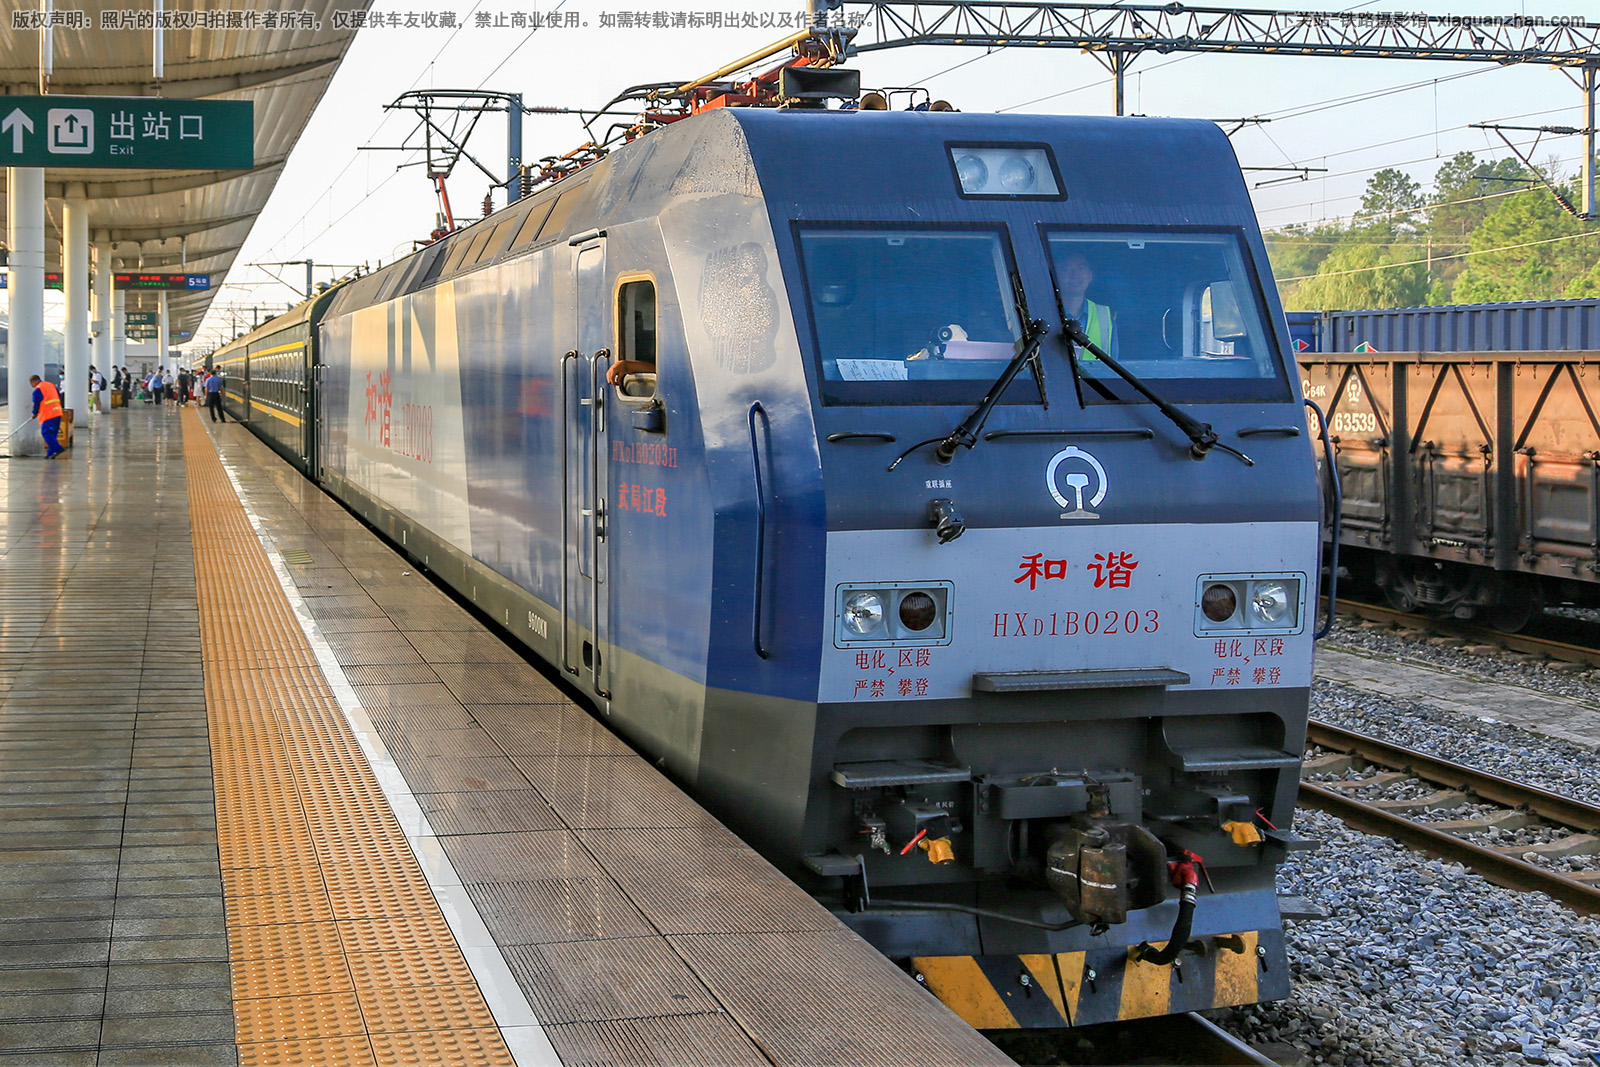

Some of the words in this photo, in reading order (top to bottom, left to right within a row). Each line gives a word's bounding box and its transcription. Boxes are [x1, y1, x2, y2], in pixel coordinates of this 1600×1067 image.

[110, 110, 203, 140] 出站口
[110, 144, 134, 155] Exit
[188, 277, 196, 287] 5
[1302, 379, 1326, 398] C64K
[365, 368, 392, 448] 和谐
[1335, 412, 1376, 432] 63539
[618, 481, 667, 517] 武局江段
[1013, 551, 1140, 591] 和谐
[993, 609, 1160, 638] HXD1B0203
[1214, 639, 1243, 658] 电化
[1253, 638, 1285, 657] 区段
[855, 649, 886, 670] 电化
[898, 648, 931, 668] 区段
[1210, 667, 1241, 686] 严禁
[1252, 666, 1281, 685] 攀登
[853, 679, 885, 699] 严禁
[898, 678, 929, 697] 攀登
